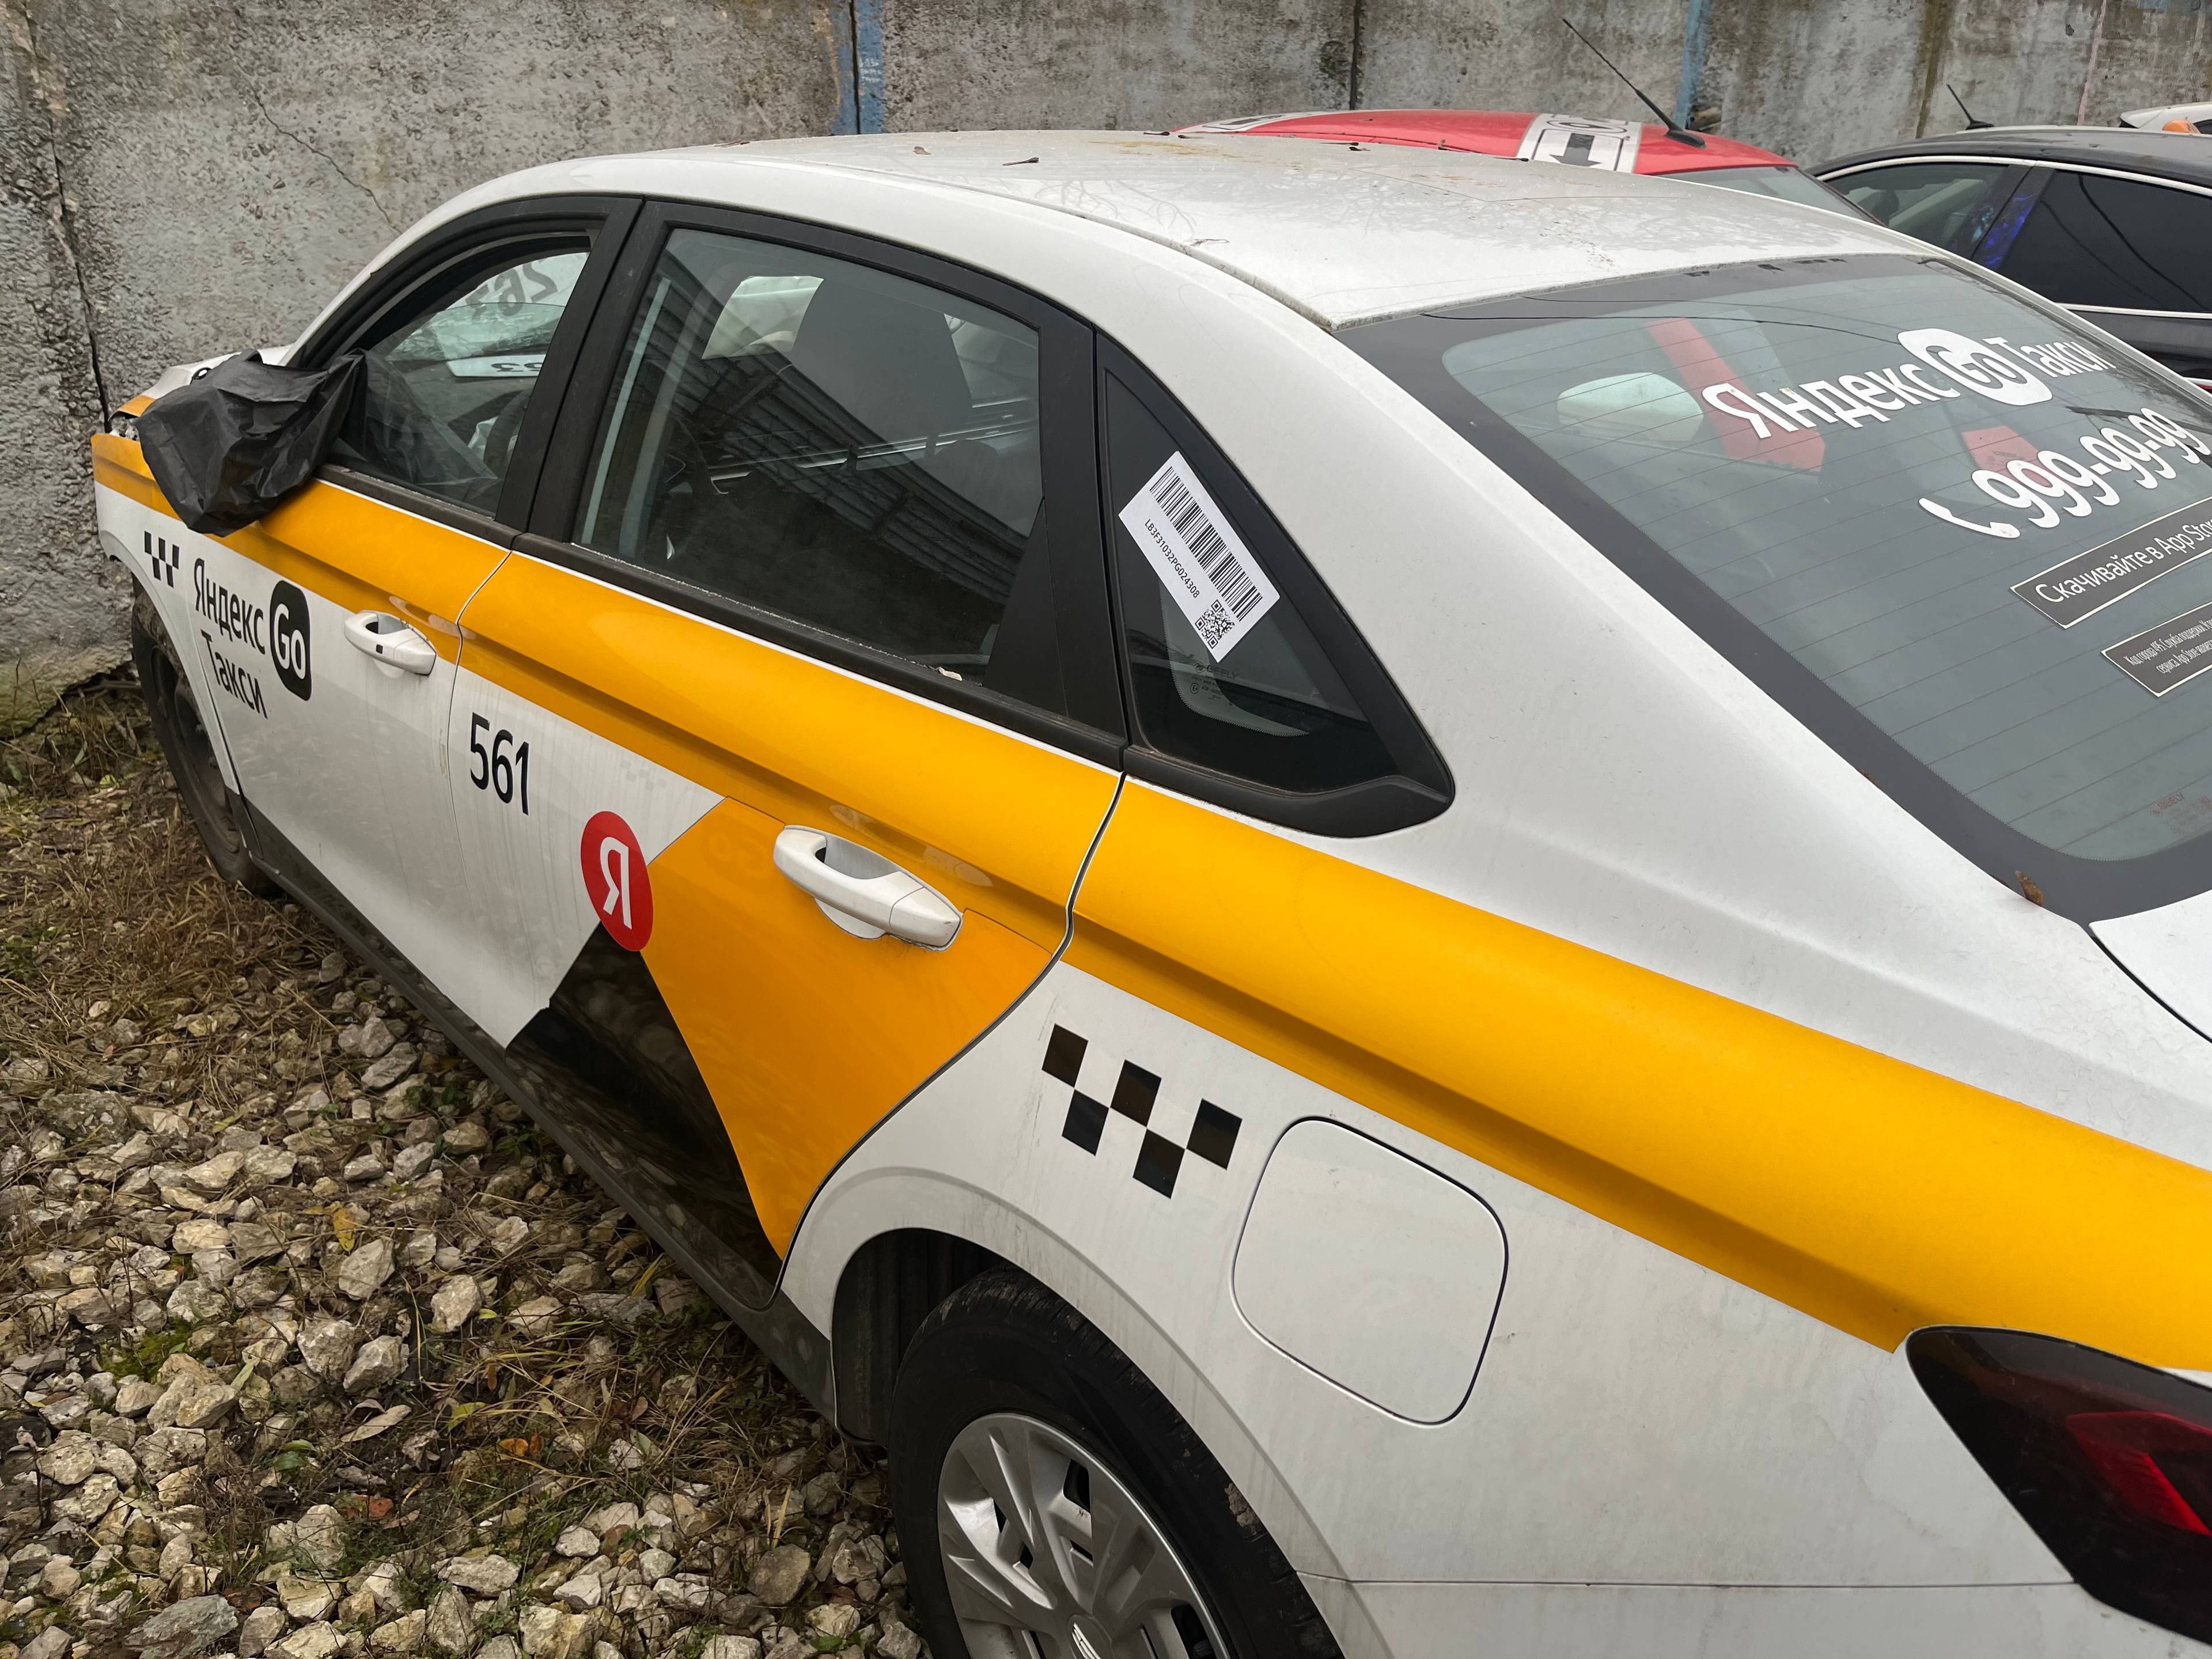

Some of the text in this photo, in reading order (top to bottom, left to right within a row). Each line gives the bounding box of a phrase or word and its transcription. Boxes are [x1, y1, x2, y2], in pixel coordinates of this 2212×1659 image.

[1702, 336, 2117, 439] Яндекс Go Такси
[1971, 407, 2211, 528] 999-99-99
[1145, 519, 1200, 598] LB3F31032PG024308
[2035, 519, 2212, 603] Скачивайте в App Stor
[194, 558, 306, 680] Яндекс Go
[200, 628, 268, 720] Такси
[470, 711, 529, 816] 561
[600, 836, 632, 930] Я
